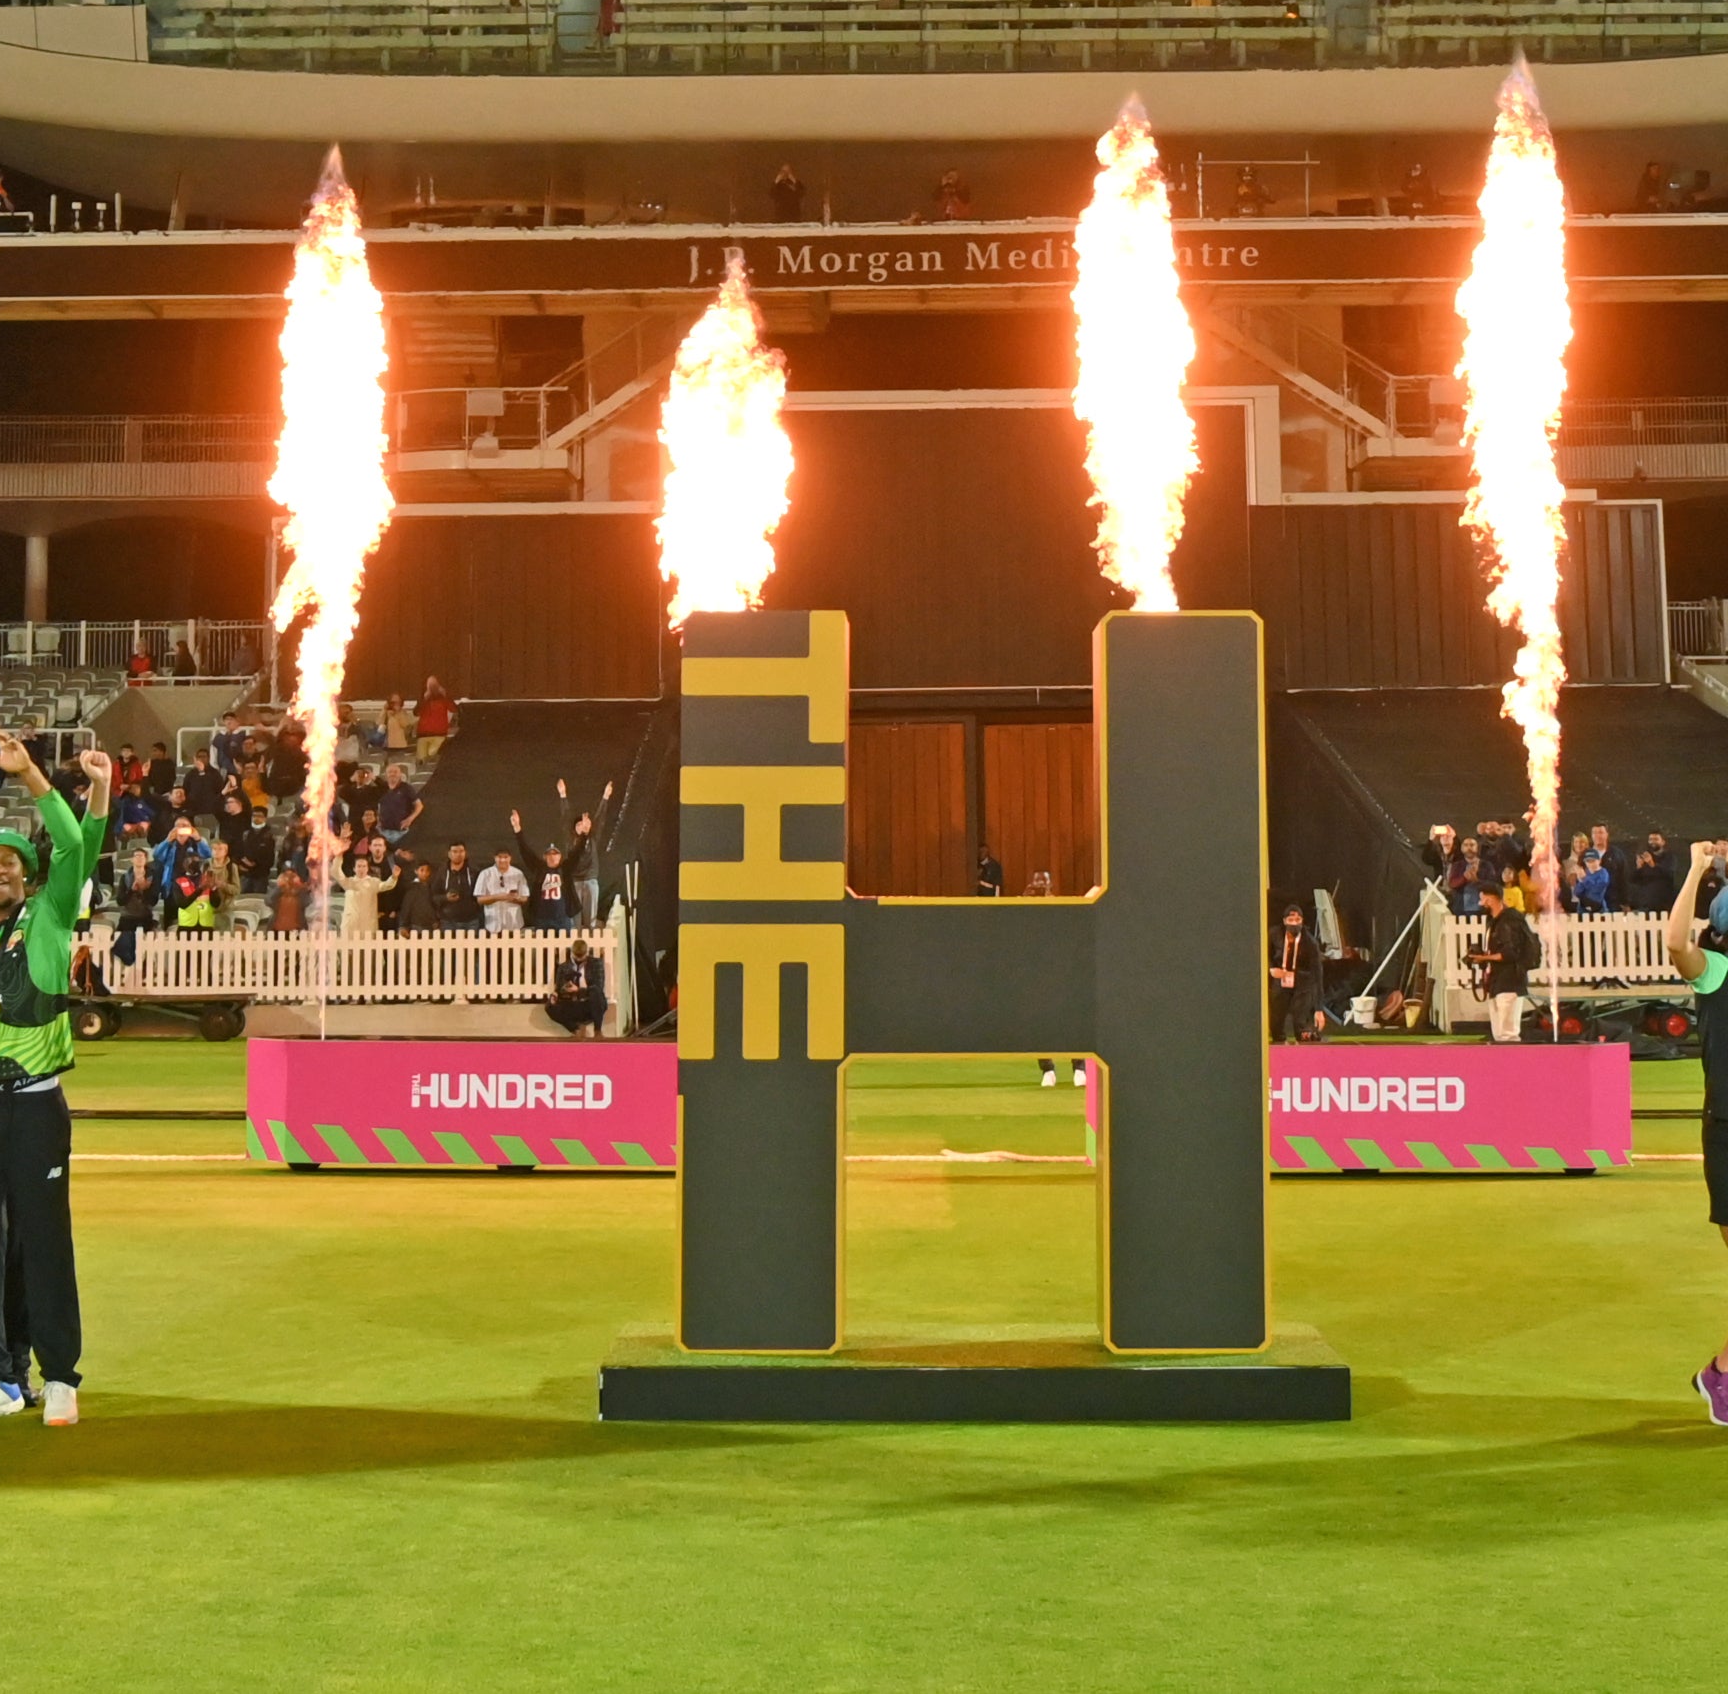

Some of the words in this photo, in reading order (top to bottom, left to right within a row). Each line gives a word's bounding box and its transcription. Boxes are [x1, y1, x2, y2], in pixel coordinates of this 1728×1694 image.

[776, 244, 944, 283] Morgan
[965, 239, 1069, 271] Medi
[677, 609, 847, 1060] THE
[412, 1073, 613, 1110] HUNDRED
[1269, 1077, 1465, 1112] HUNDRED
